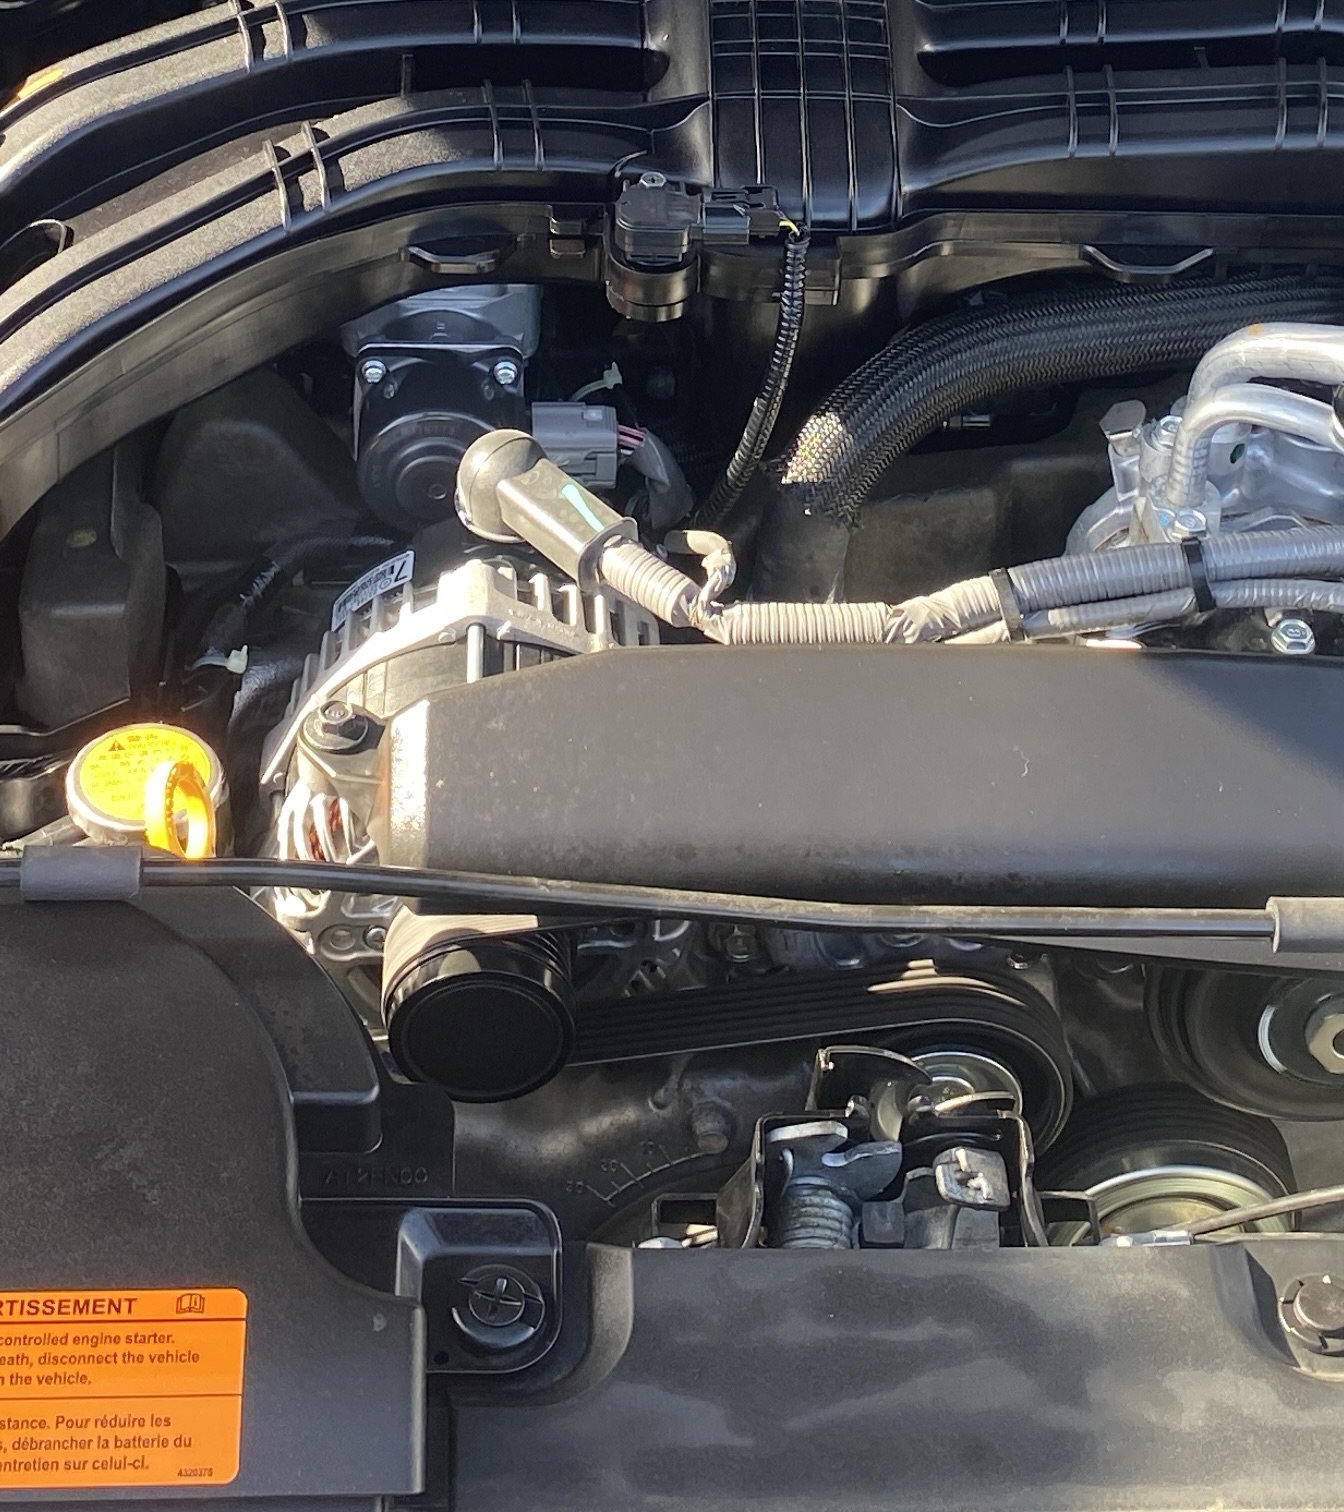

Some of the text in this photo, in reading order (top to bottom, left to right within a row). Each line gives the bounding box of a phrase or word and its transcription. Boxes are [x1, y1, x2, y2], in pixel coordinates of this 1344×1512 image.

[72, 1331, 121, 1348] engine
[124, 1331, 176, 1344] starter.
[38, 1351, 118, 1366] disconnect
[121, 1350, 145, 1364] the
[148, 1350, 201, 1364] vehicle
[9, 1372, 32, 1385] the
[36, 1371, 92, 1385] vehicle.
[55, 1415, 91, 1429] Pour
[93, 1414, 146, 1428] réduire
[150, 1413, 172, 1428] les
[11, 1436, 94, 1451] débrancher
[96, 1436, 110, 1449] la
[114, 1435, 169, 1449] batterie
[173, 1434, 192, 1448] du
[63, 1459, 89, 1471] sur
[92, 1456, 150, 1471] celui-ci.
